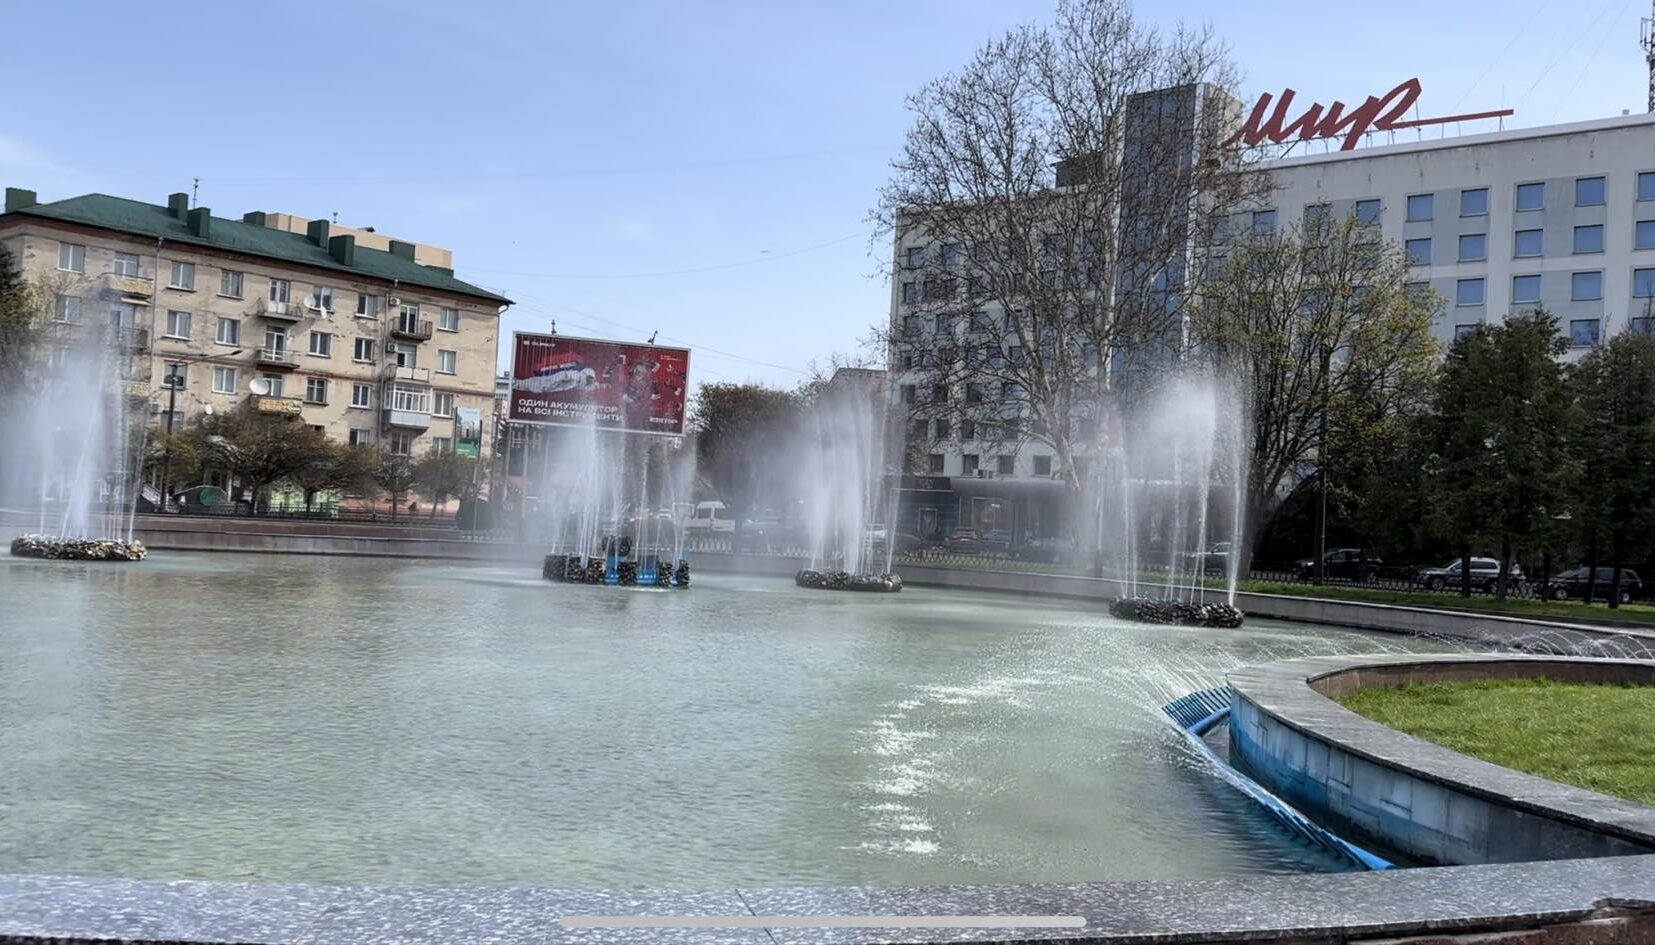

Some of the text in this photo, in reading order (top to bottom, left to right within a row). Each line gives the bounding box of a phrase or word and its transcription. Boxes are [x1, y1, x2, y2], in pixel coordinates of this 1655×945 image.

[518, 398, 548, 408] ОДИН
[534, 408, 551, 416] ВСІ
[552, 410, 624, 421] ІНСТРЕНТИ
